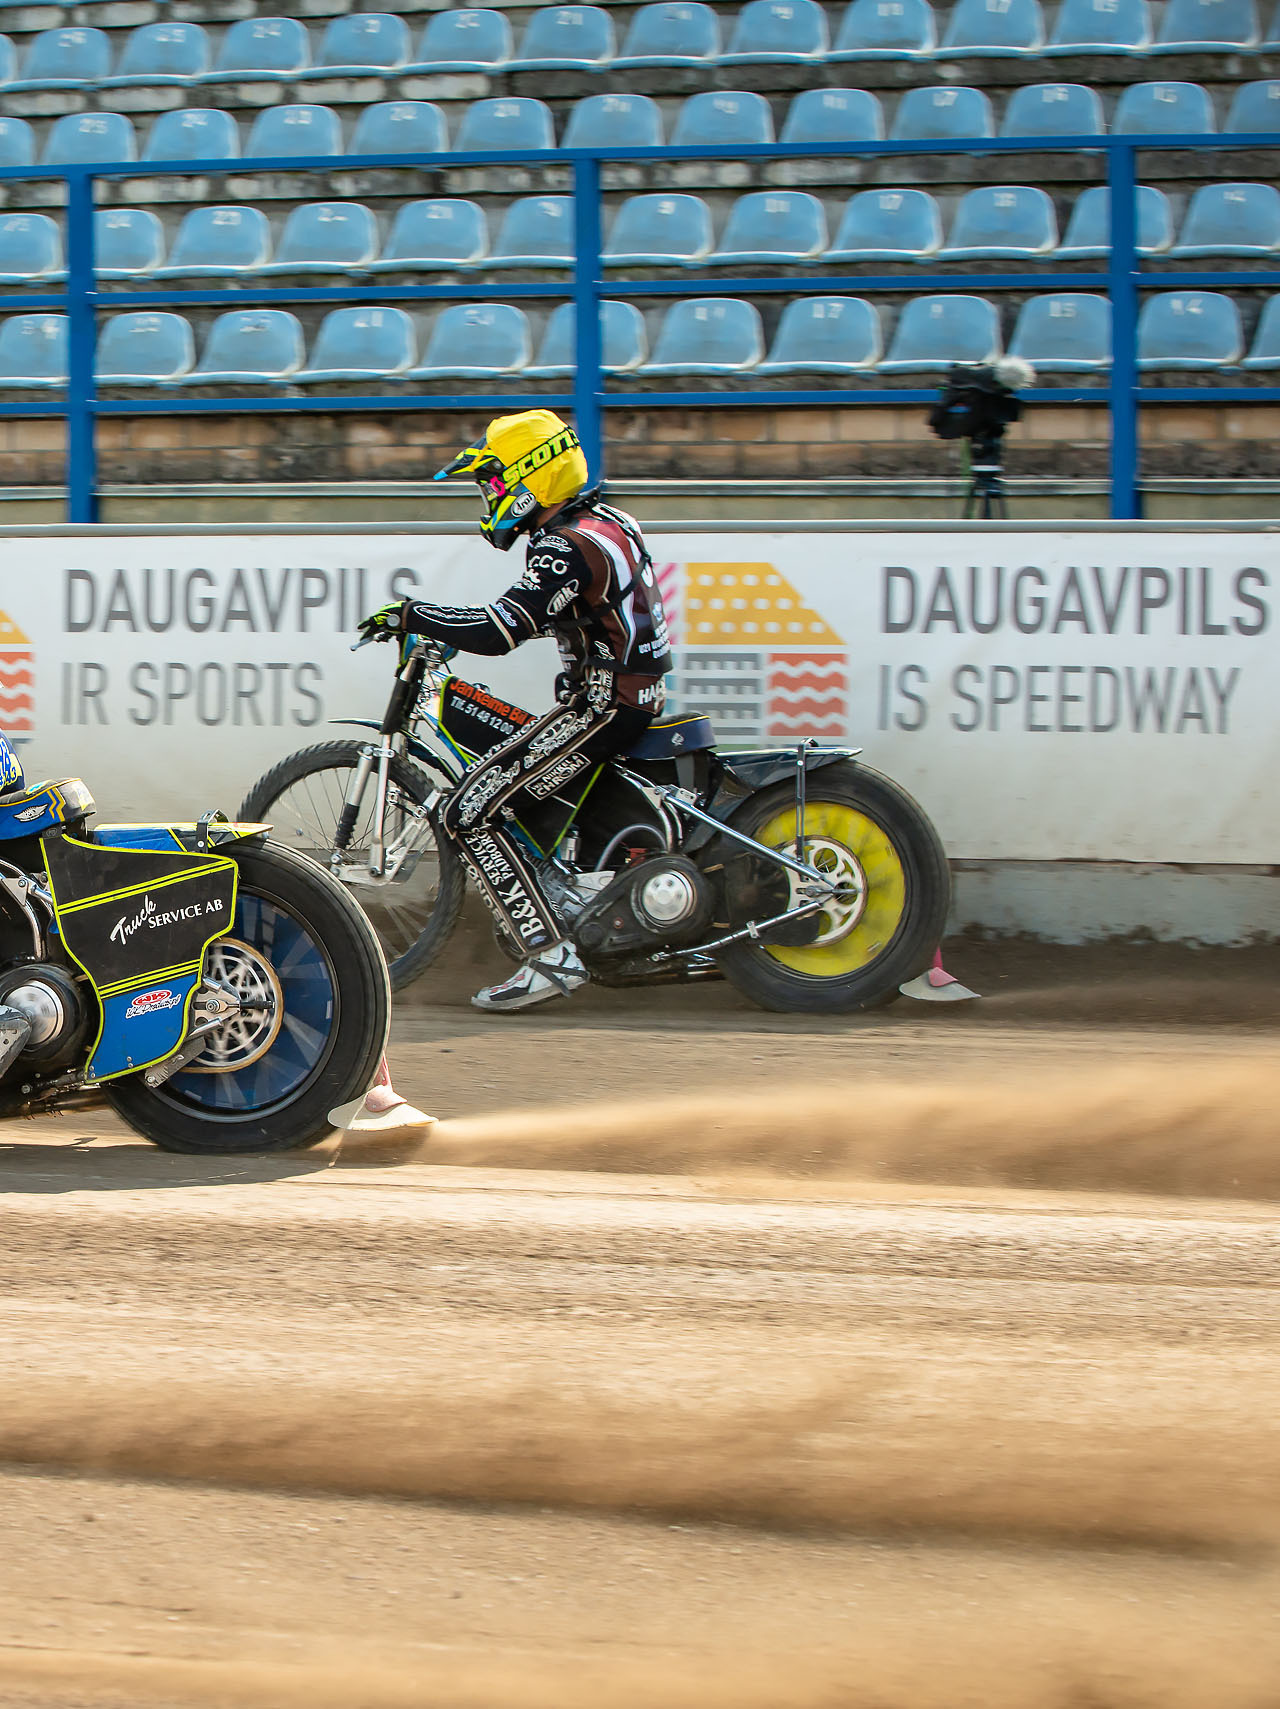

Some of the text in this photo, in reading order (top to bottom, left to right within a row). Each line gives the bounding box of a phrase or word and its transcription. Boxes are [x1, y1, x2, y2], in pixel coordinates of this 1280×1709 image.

[503, 430, 575, 489] SCOTT
[880, 565, 1271, 636] DAUGAVPILS
[60, 662, 325, 727] IR SPORTS
[450, 680, 473, 698] Jan
[465, 704, 479, 717] 51
[488, 716, 503, 730] 12
[877, 664, 1242, 734] IS SPEEDWAY
[465, 834, 502, 886] SERVICE
[110, 895, 224, 945] Truck SERVICE AB
[497, 879, 546, 939] B&K
